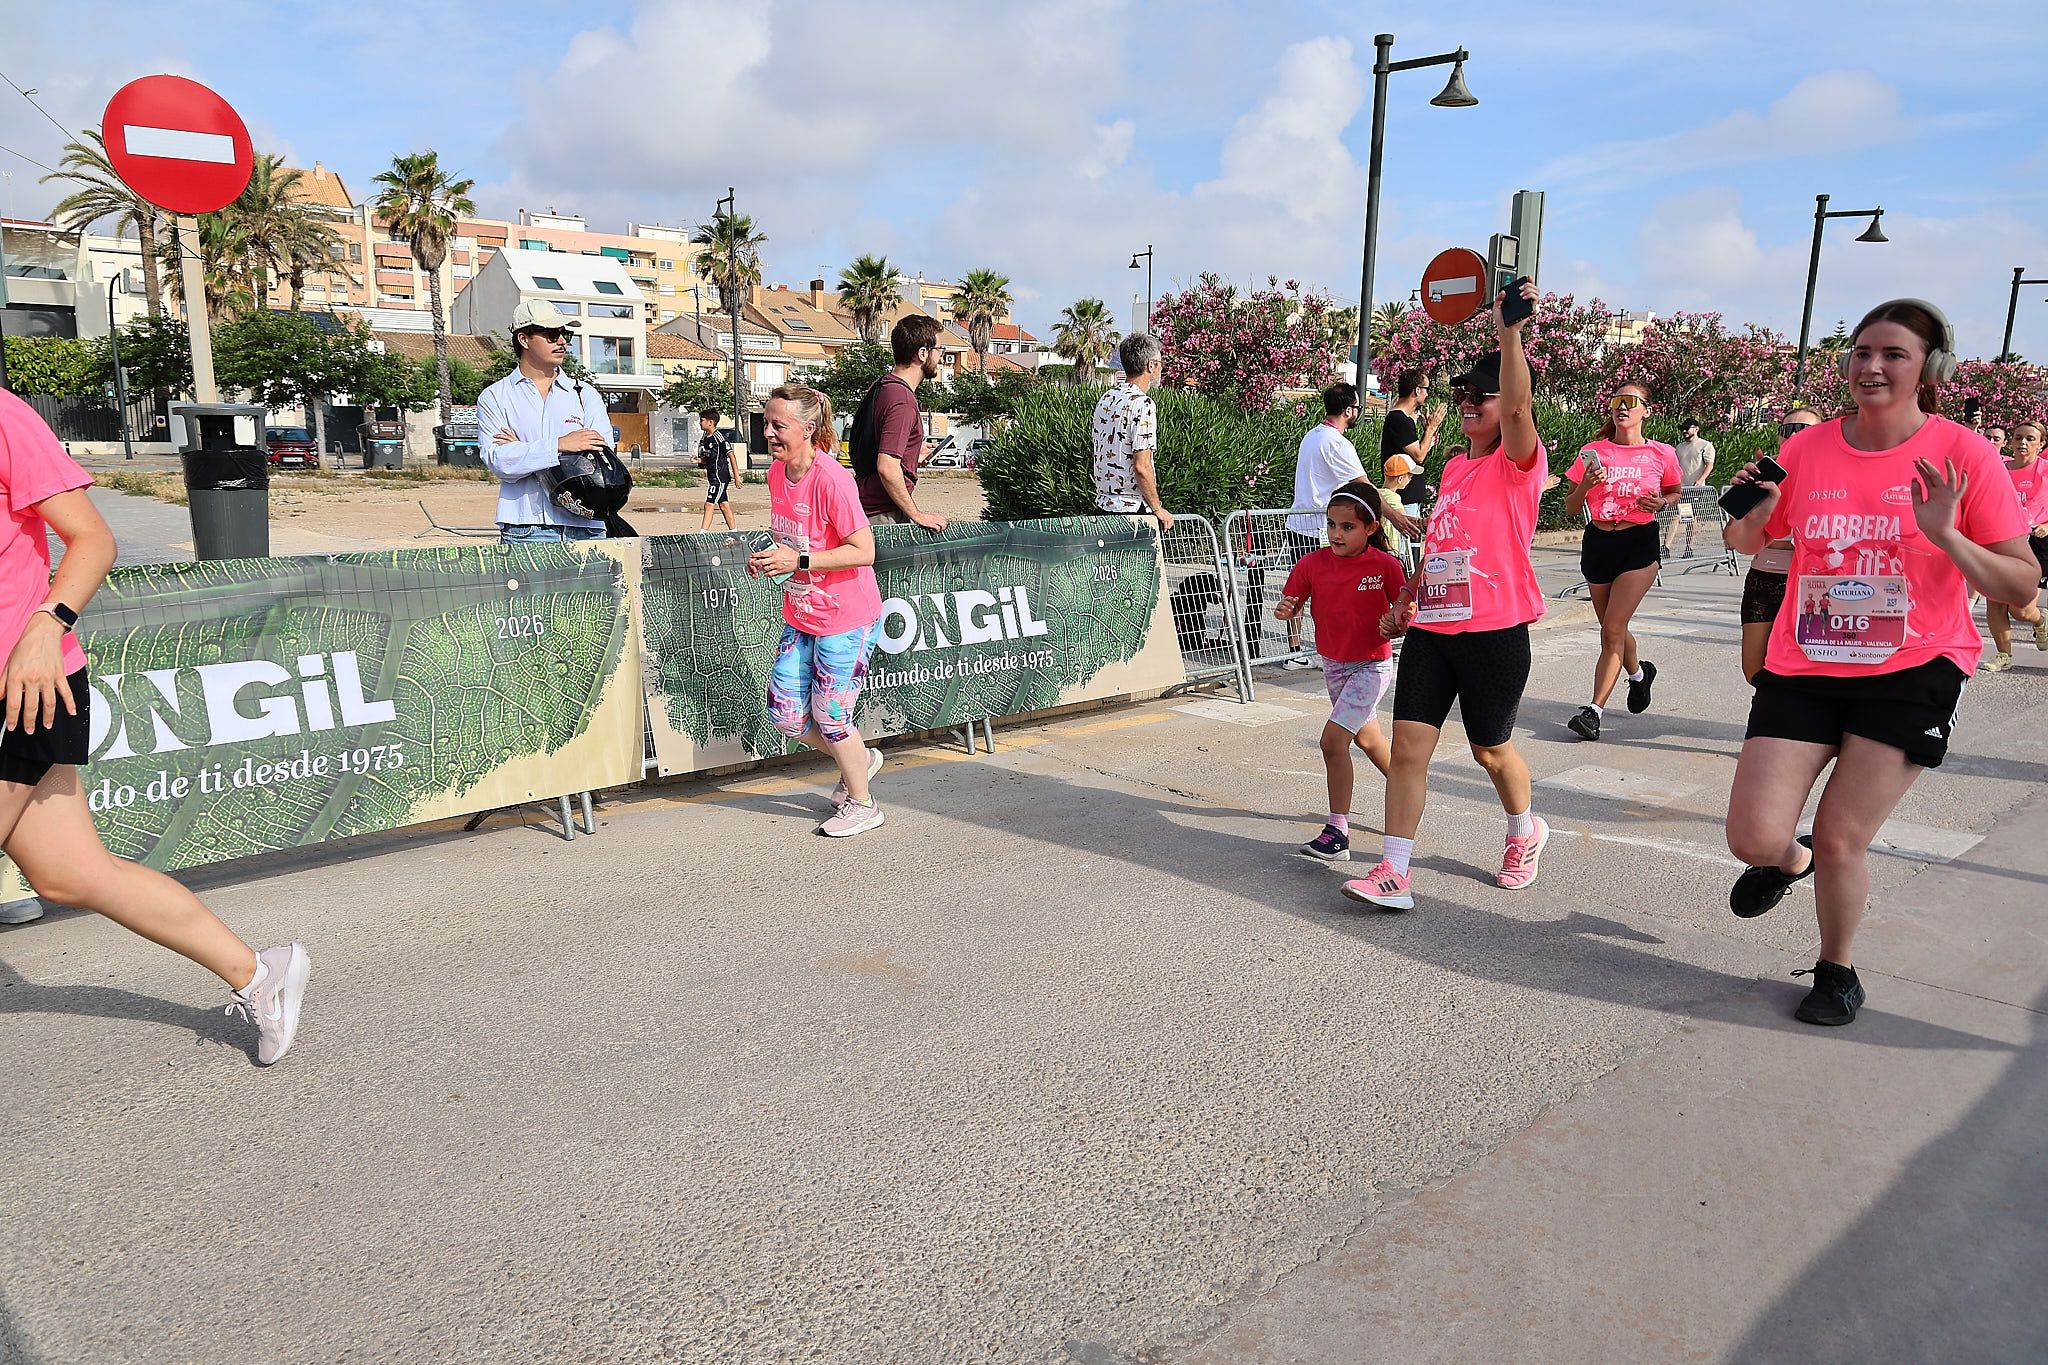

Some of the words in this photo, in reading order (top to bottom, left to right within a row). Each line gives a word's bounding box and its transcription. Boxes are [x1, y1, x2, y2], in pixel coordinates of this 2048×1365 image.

[1808, 489, 1847, 500] OYSHO
[1804, 514, 1900, 541] CARRERA
[1093, 565, 1118, 581] 2026
[1357, 583, 1367, 591] la
[1427, 584, 1447, 597] 016
[1832, 588, 1871, 596] ASTURIANA
[701, 587, 739, 609] 1975
[496, 614, 545, 639] 2026
[1830, 615, 1870, 630] 016
[1805, 648, 1838, 657] OYSHO
[934, 660, 954, 680] de
[957, 656, 971, 677] ti
[973, 651, 1018, 675] desde
[1021, 649, 1053, 670] 1975
[88, 779, 136, 812] do
[146, 771, 190, 803] de
[198, 763, 226, 794] ti
[232, 750, 329, 789] desde
[337, 742, 404, 775] 1975
